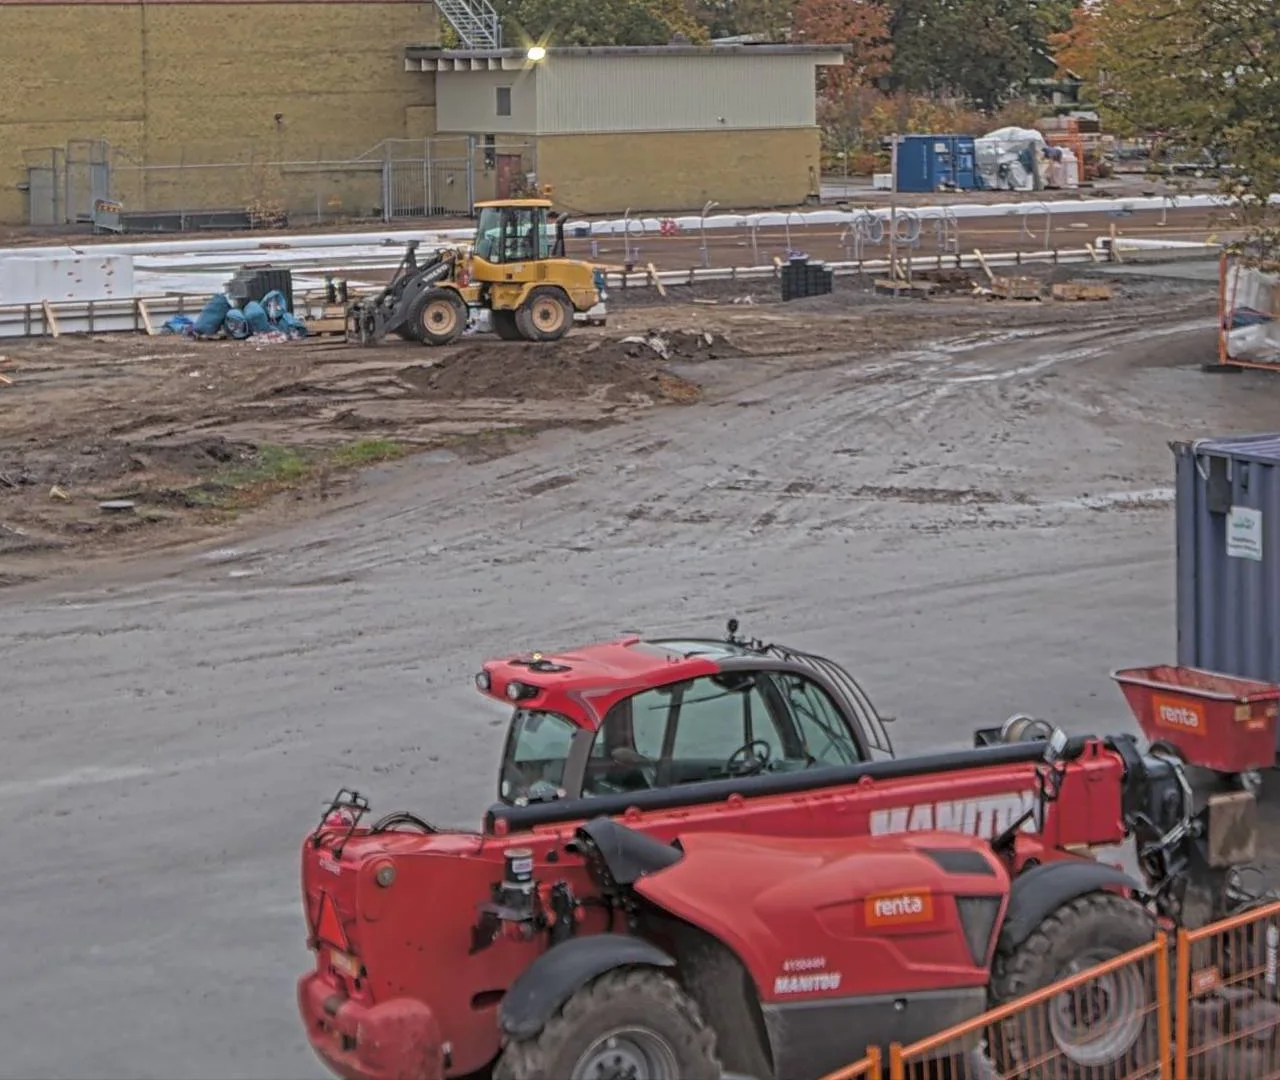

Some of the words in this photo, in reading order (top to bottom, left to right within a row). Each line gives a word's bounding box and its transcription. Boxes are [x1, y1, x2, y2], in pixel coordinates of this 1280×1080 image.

[1159, 704, 1199, 728] renta
[874, 894, 924, 918] renta
[774, 971, 842, 995] MANITOU
